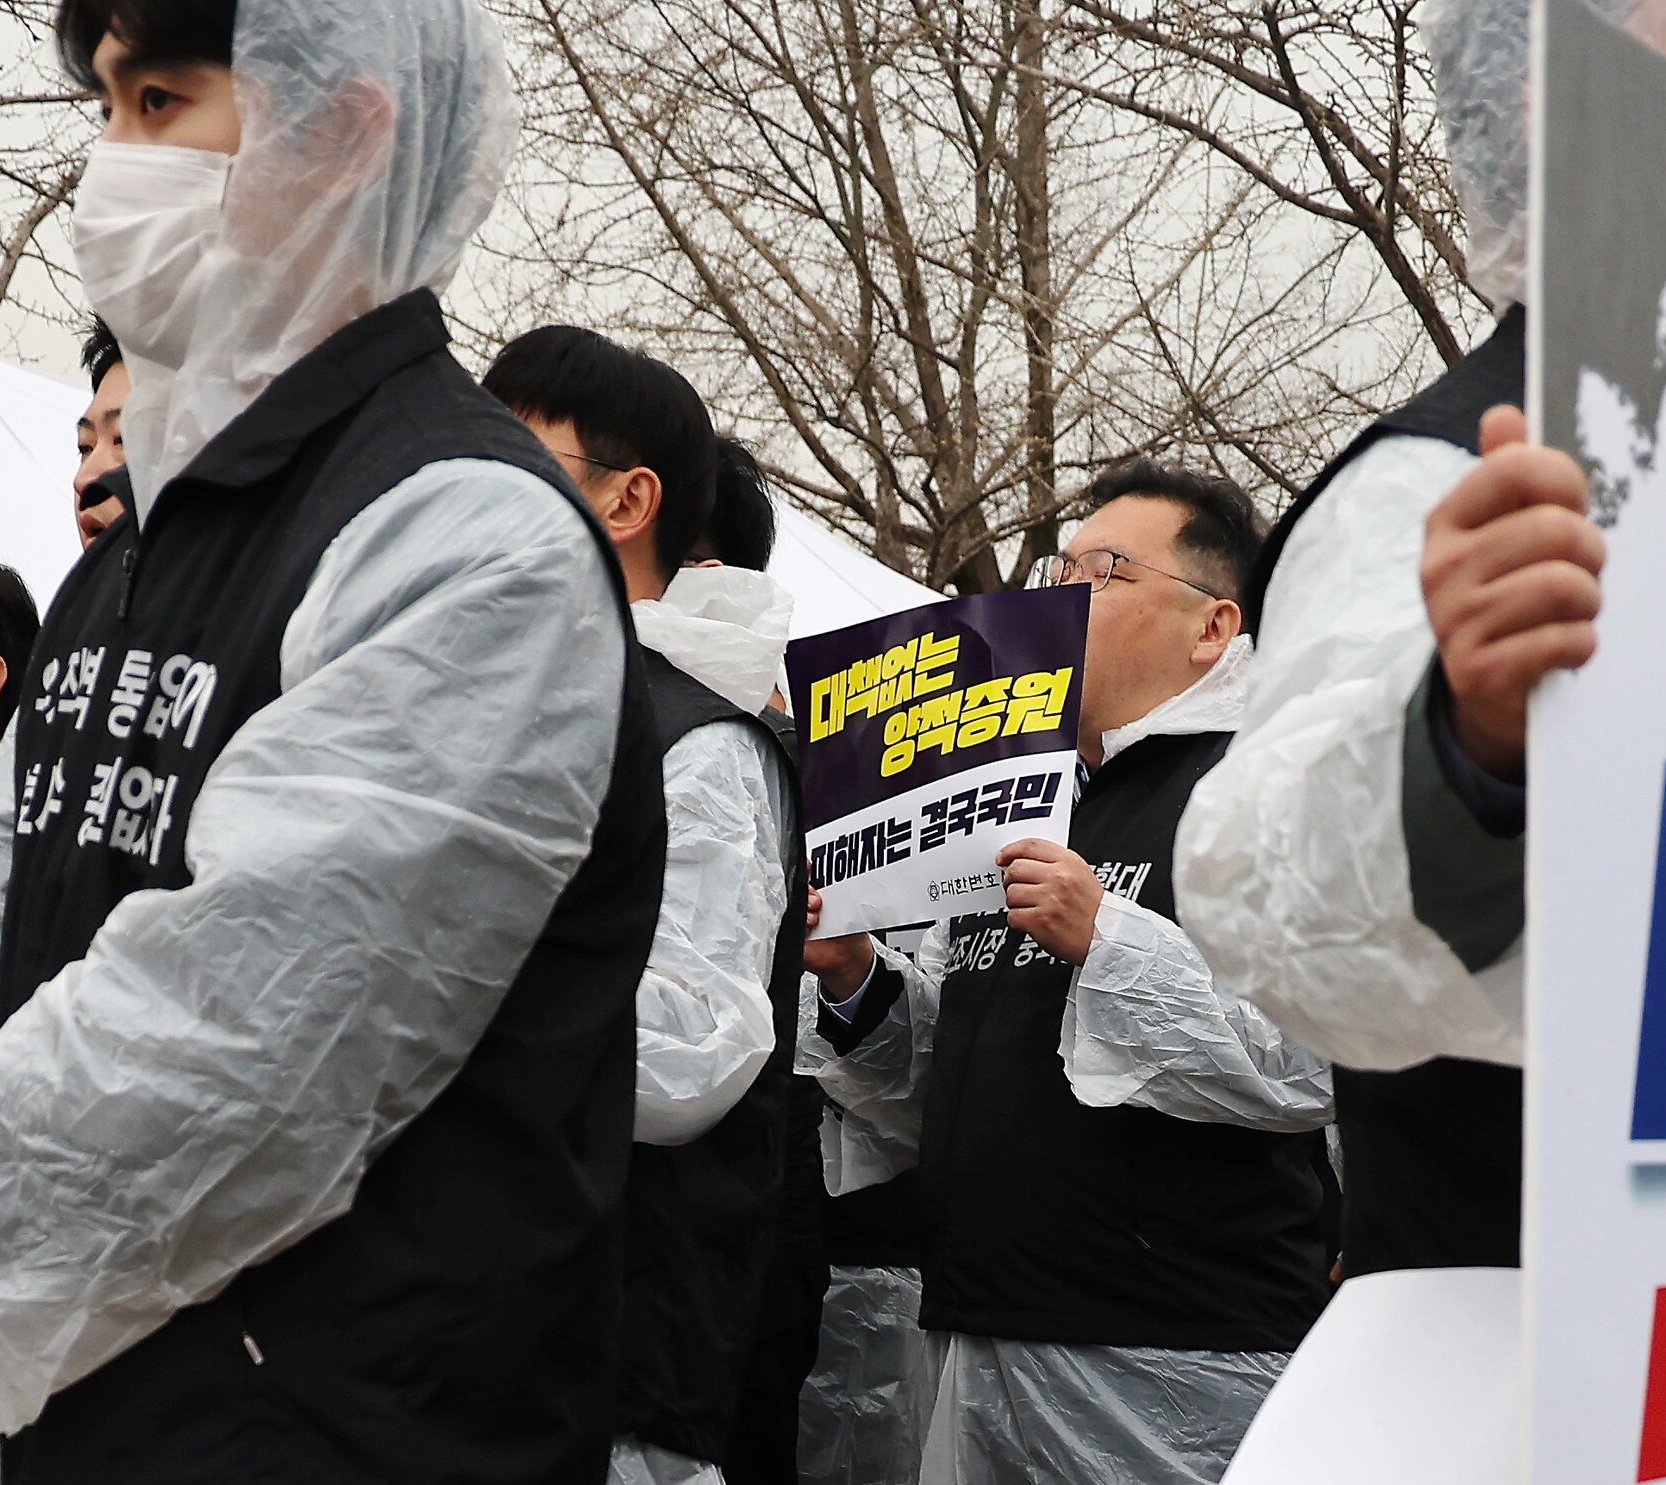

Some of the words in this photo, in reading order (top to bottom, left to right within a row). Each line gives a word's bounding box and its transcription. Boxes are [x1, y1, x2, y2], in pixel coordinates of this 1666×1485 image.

[810, 631, 960, 743] 대책없는
[880, 666, 1074, 778] 양적증원
[810, 816, 912, 888] 피해자는
[919, 772, 1064, 854] 결국국민
[940, 870, 1004, 896] 대한변호
